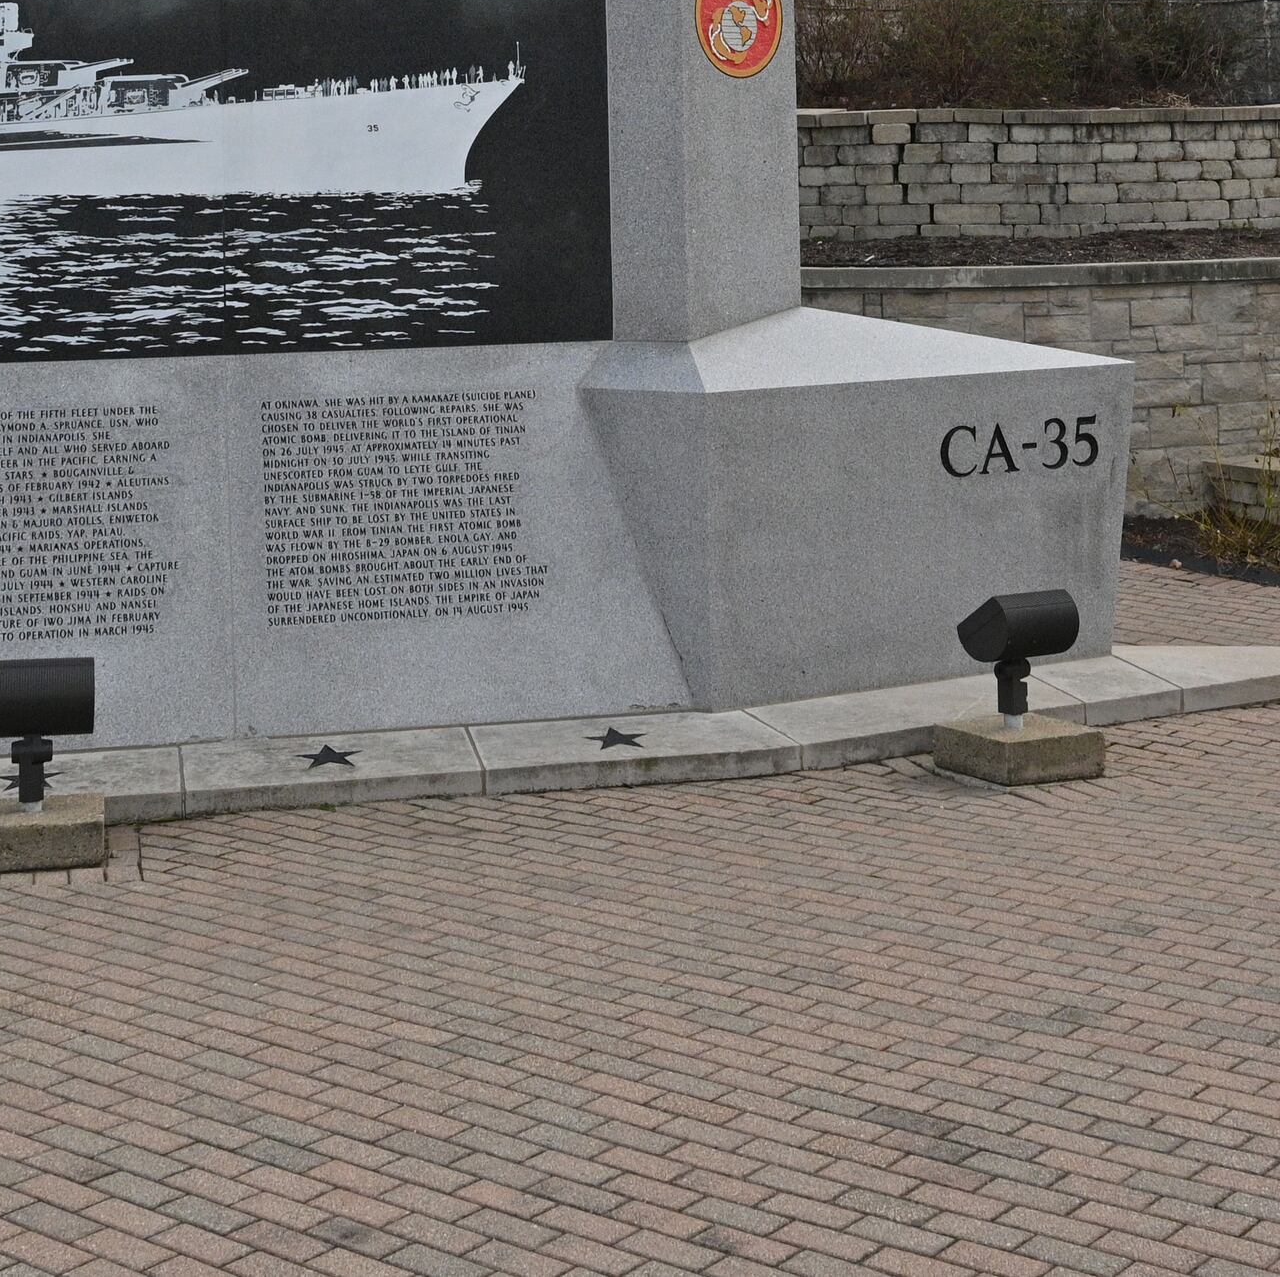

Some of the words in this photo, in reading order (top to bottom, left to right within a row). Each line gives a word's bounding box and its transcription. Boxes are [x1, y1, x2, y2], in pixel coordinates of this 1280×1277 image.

[367, 124, 379, 133] 35
[261, 411, 301, 421] CAUSING
[382, 406, 435, 416] FOLLOWING
[261, 423, 298, 433] CHOSEN
[319, 420, 357, 430] DELIVER
[427, 416, 451, 426] FIRST
[455, 414, 517, 425] OPERATIONAL
[261, 435, 295, 445] ATOMIC
[333, 431, 387, 441] DELIVERING
[442, 427, 475, 437] ISLAND
[495, 425, 525, 435] TINIAN
[91, 443, 127, 452] SERVED
[131, 441, 169, 451] ABOARD
[365, 440, 437, 452] APPROXIMATELY
[456, 438, 495, 448] MINUTES
[940, 413, 1099, 478] CA-35
[103, 454, 145, 464] EARNING
[263, 458, 308, 468] MIDNIGHT
[436, 450, 489, 460] TRANSITING
[53, 467, 122, 478] BOUGAINVILLE
[263, 469, 323, 480] UNESCORTED
[404, 464, 430, 474] LEYTE
[25, 481, 73, 491] FEBRUARY
[263, 481, 329, 492] INDIANAPOLIS
[358, 478, 392, 488] STRUCK
[437, 473, 489, 484] TORPEDOES
[48, 492, 87, 502] GILBERT
[92, 491, 132, 500] ISLANDS
[302, 491, 355, 502] SUBMARINE
[423, 486, 464, 496] IMPERIAL
[468, 484, 514, 494] JAPANESE
[52, 504, 102, 514] MARSHALL
[107, 502, 147, 512] ISLANDS
[373, 499, 438, 510] INDIANAPOLIS
[488, 496, 510, 505] LAST
[265, 518, 304, 528] SURFACE
[432, 510, 465, 519] UNITED
[470, 508, 501, 518] STATES
[371, 525, 402, 534] TINIAN
[458, 520, 491, 530] ATOMIC
[29, 542, 78, 552] MARIANAS
[290, 541, 322, 551] FLOWN
[438, 533, 469, 543] ENOLA
[52, 553, 104, 564] PHILIPPINE
[266, 554, 308, 564] DROPPED
[451, 544, 489, 554] AUGUST
[137, 562, 178, 572] CAPTURE
[355, 561, 398, 571] BROUGHT
[460, 557, 488, 566] EARLY
[70, 577, 115, 588] WESTERN
[120, 575, 167, 585] CAROLINE
[317, 576, 351, 586] SAVING
[374, 572, 424, 583] ESTIMATED
[454, 568, 491, 578] MILLION
[438, 582, 464, 591] SIDES
[500, 578, 544, 588] INVASION
[17, 592, 71, 602] SEPTEMBER
[307, 600, 352, 611] JAPANESE
[458, 593, 490, 602] EMPIRE
[112, 612, 159, 623] FEBRUARY
[268, 614, 335, 626] SURRENDERED
[467, 604, 503, 614] AUGUST
[18, 629, 73, 640] OPERATION
